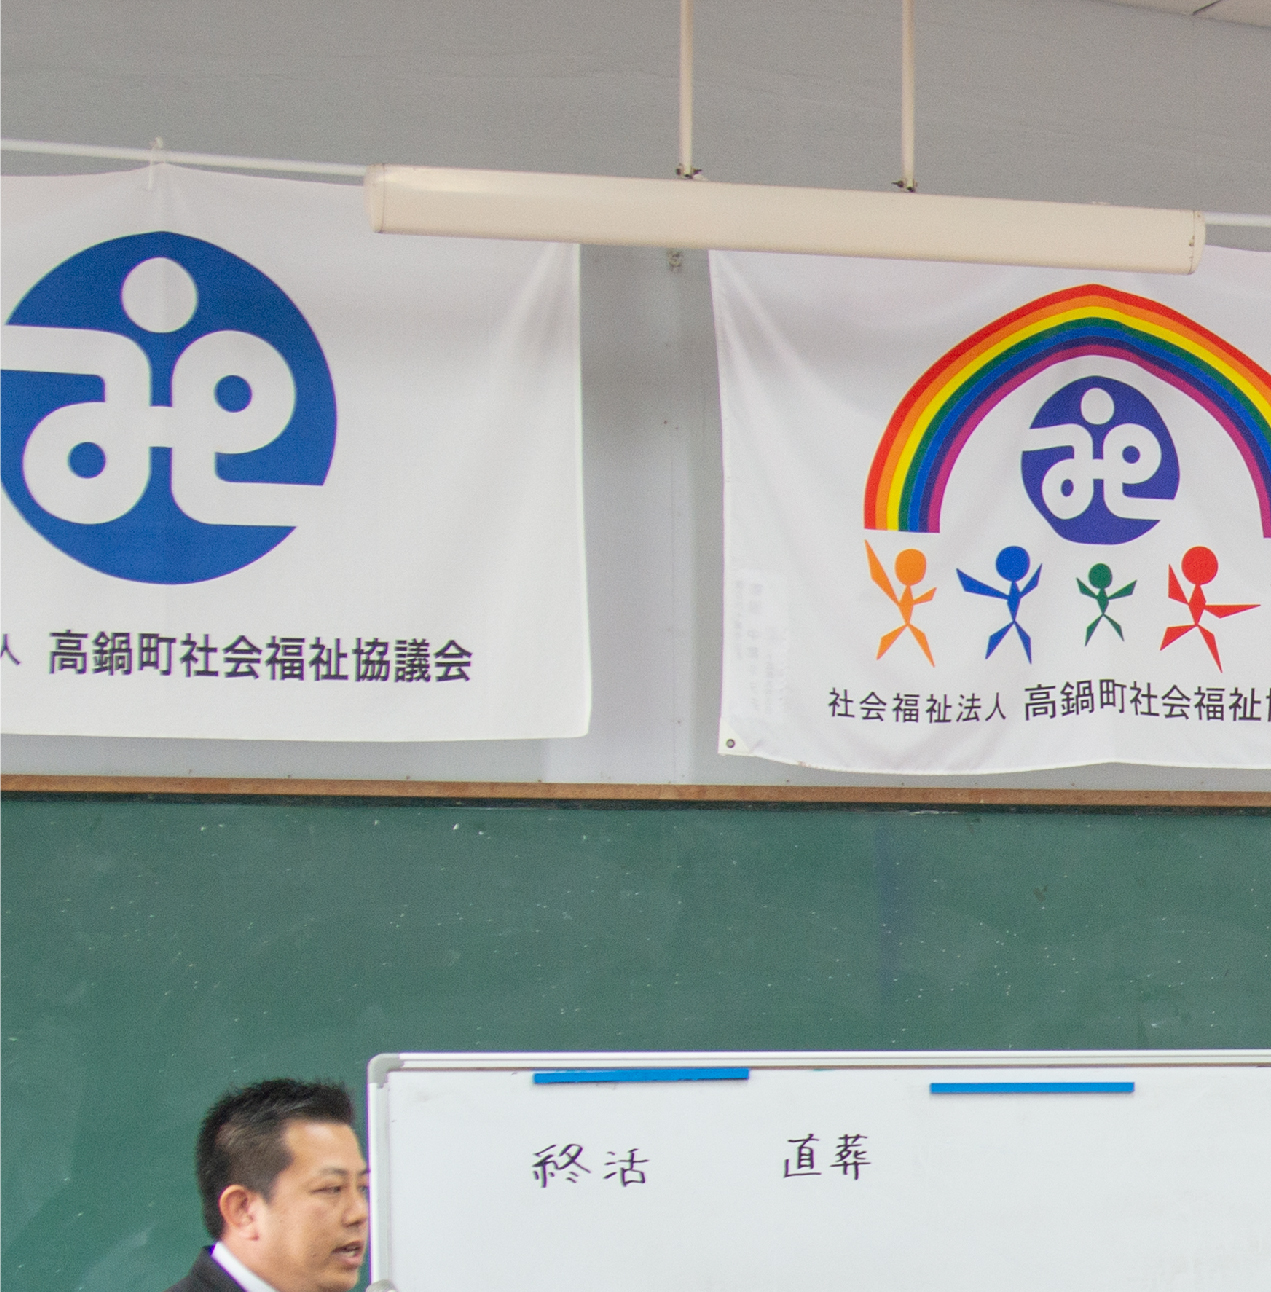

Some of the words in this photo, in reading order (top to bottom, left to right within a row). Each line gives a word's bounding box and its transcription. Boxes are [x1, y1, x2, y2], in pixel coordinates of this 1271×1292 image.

[48, 630, 474, 682] 高鍋町社会福祉協議会
[828, 688, 1007, 724] 社会福祉法人
[532, 1143, 650, 1188] 終活
